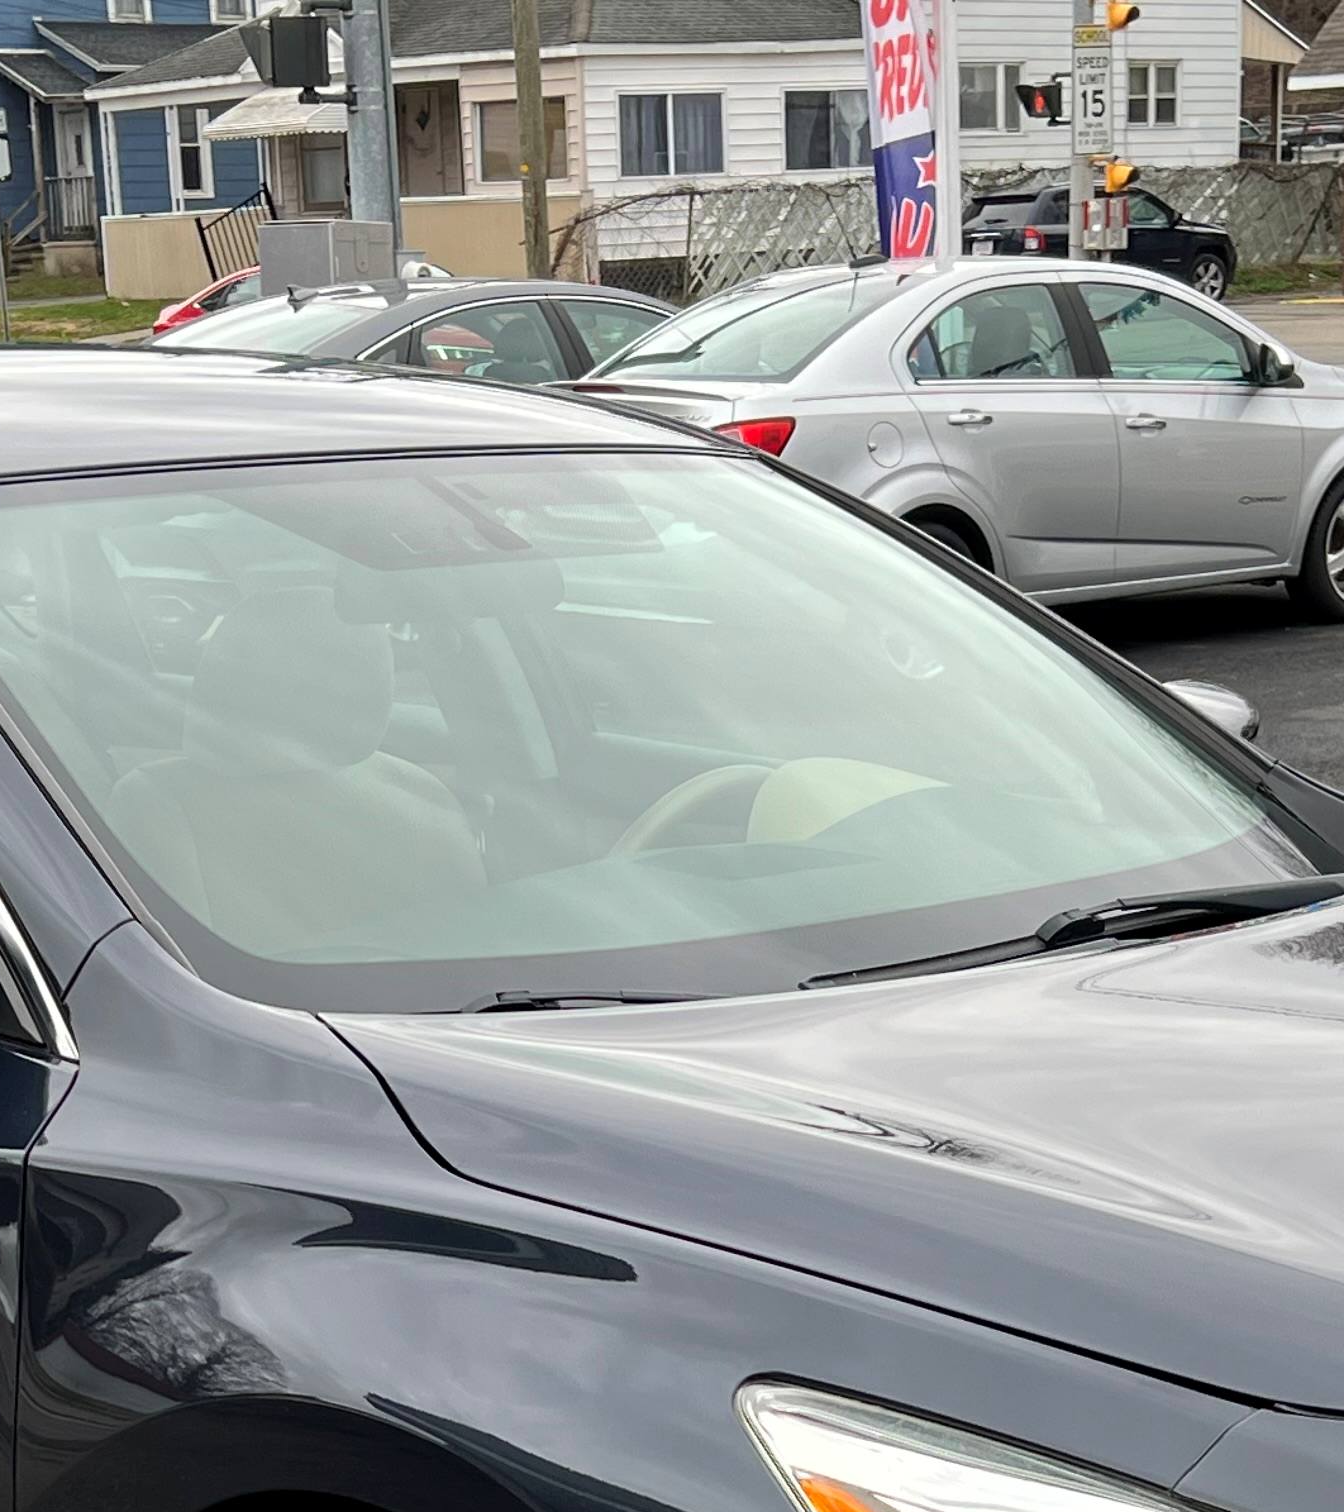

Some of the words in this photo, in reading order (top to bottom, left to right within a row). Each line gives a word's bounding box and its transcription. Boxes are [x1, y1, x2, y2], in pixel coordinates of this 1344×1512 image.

[1076, 56, 1109, 69] SPEED
[1078, 72, 1106, 86] LIMIT
[1081, 89, 1106, 118] 15
